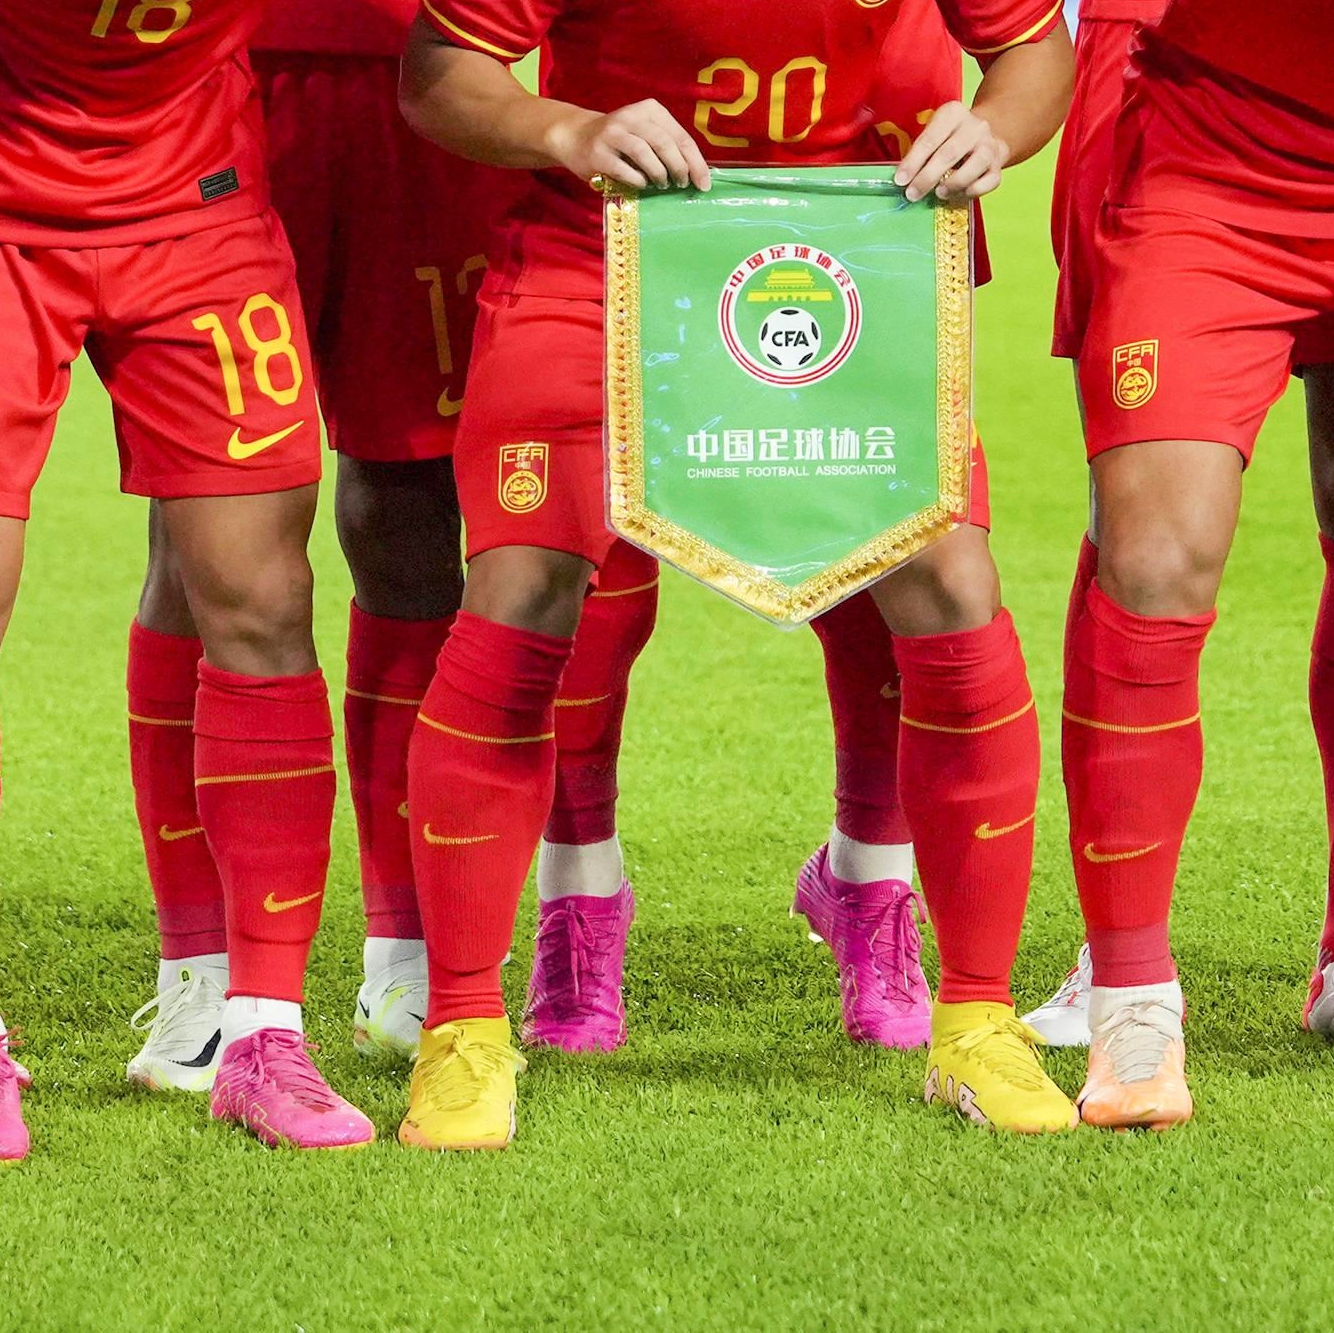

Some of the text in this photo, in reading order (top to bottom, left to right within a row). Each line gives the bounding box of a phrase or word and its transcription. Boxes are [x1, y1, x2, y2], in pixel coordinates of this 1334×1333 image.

[694, 56, 828, 148] 20
[729, 246, 851, 288] 中国足球协会
[415, 254, 489, 375] 1
[193, 292, 303, 416] 18
[771, 330, 810, 347] CFA
[1117, 344, 1154, 363] CFA
[504, 447, 544, 463] CFA
[686, 426, 896, 463] 中国足球协会
[687, 464, 897, 479] CHINESE FOOTBALL ASSOCIATION
[924, 1065, 995, 1130] AIR
